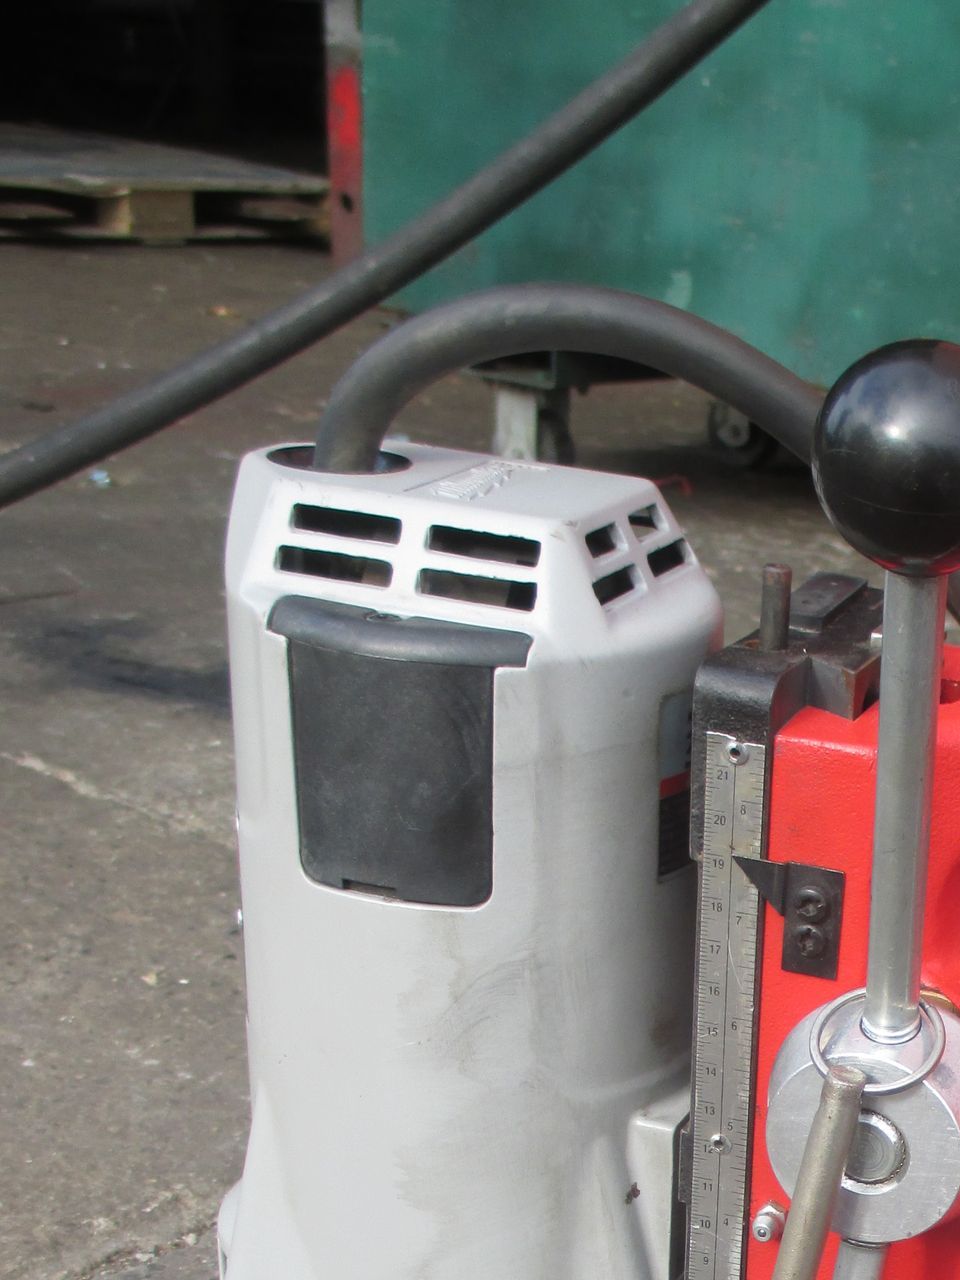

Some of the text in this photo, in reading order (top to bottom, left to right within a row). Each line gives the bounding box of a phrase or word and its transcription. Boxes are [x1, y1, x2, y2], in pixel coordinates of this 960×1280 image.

[716, 769, 729, 781] 21
[740, 804, 747, 816] 8
[713, 814, 727, 826] 20
[712, 858, 725, 870] 19
[711, 901, 723, 913] 18
[736, 915, 743, 926] 7
[710, 944, 721, 955] 17
[708, 986, 720, 996] 16
[731, 1020, 738, 1031] 6
[706, 1026, 718, 1037] 15
[705, 1066, 717, 1077] 14
[704, 1105, 715, 1116] 13
[727, 1121, 733, 1132] 5
[703, 1143, 714, 1154] 12
[703, 1181, 713, 1192] 11
[700, 1219, 711, 1229] 10
[703, 1256, 709, 1266] 9
